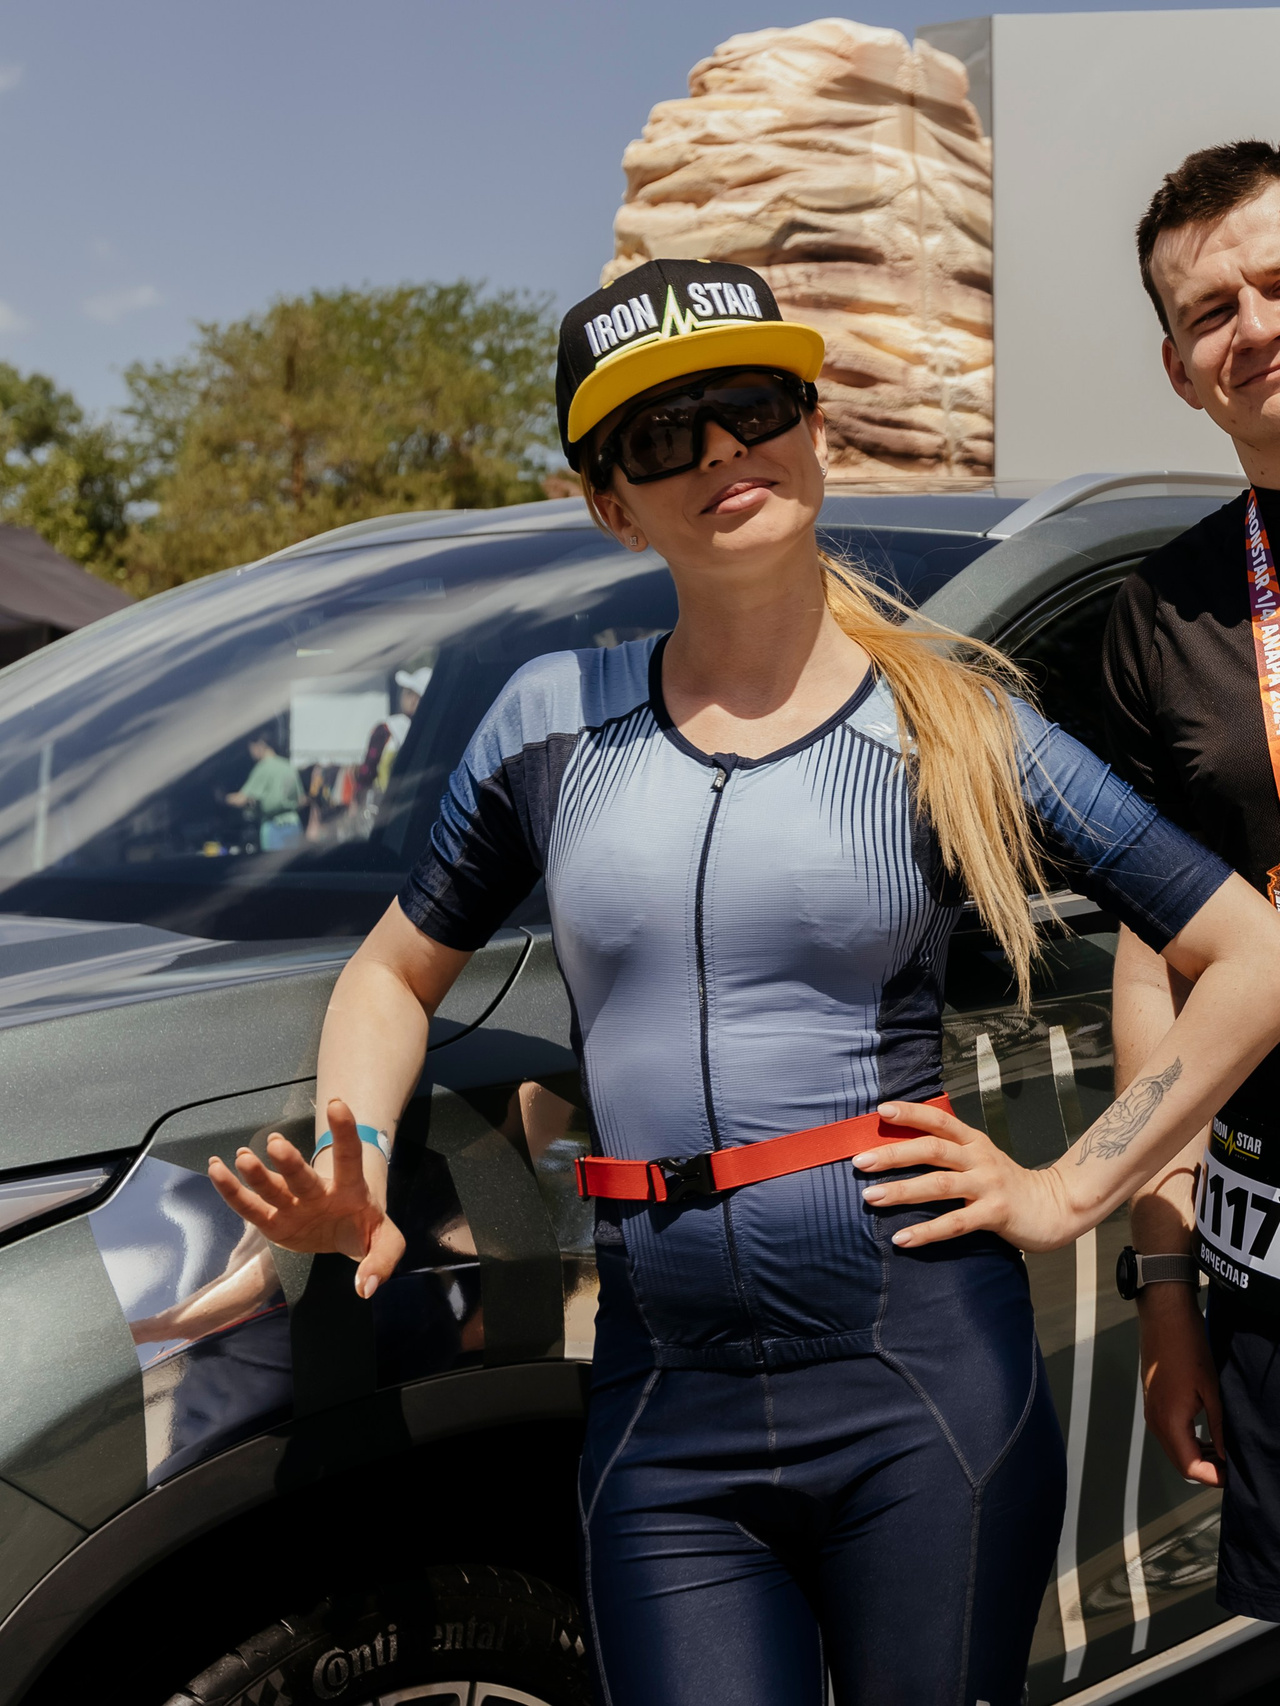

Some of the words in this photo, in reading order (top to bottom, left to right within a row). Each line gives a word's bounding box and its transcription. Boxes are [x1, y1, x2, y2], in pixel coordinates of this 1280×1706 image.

[584, 293, 659, 358] IRON
[687, 281, 763, 319] STAR
[1248, 501, 1270, 591] IRONSTAR
[1255, 589, 1277, 621] 1/4
[1236, 1131, 1262, 1155] STAR
[1200, 1242, 1250, 1289] ВЯЧЕСЛАВ
[312, 1615, 505, 1700] Contiental
